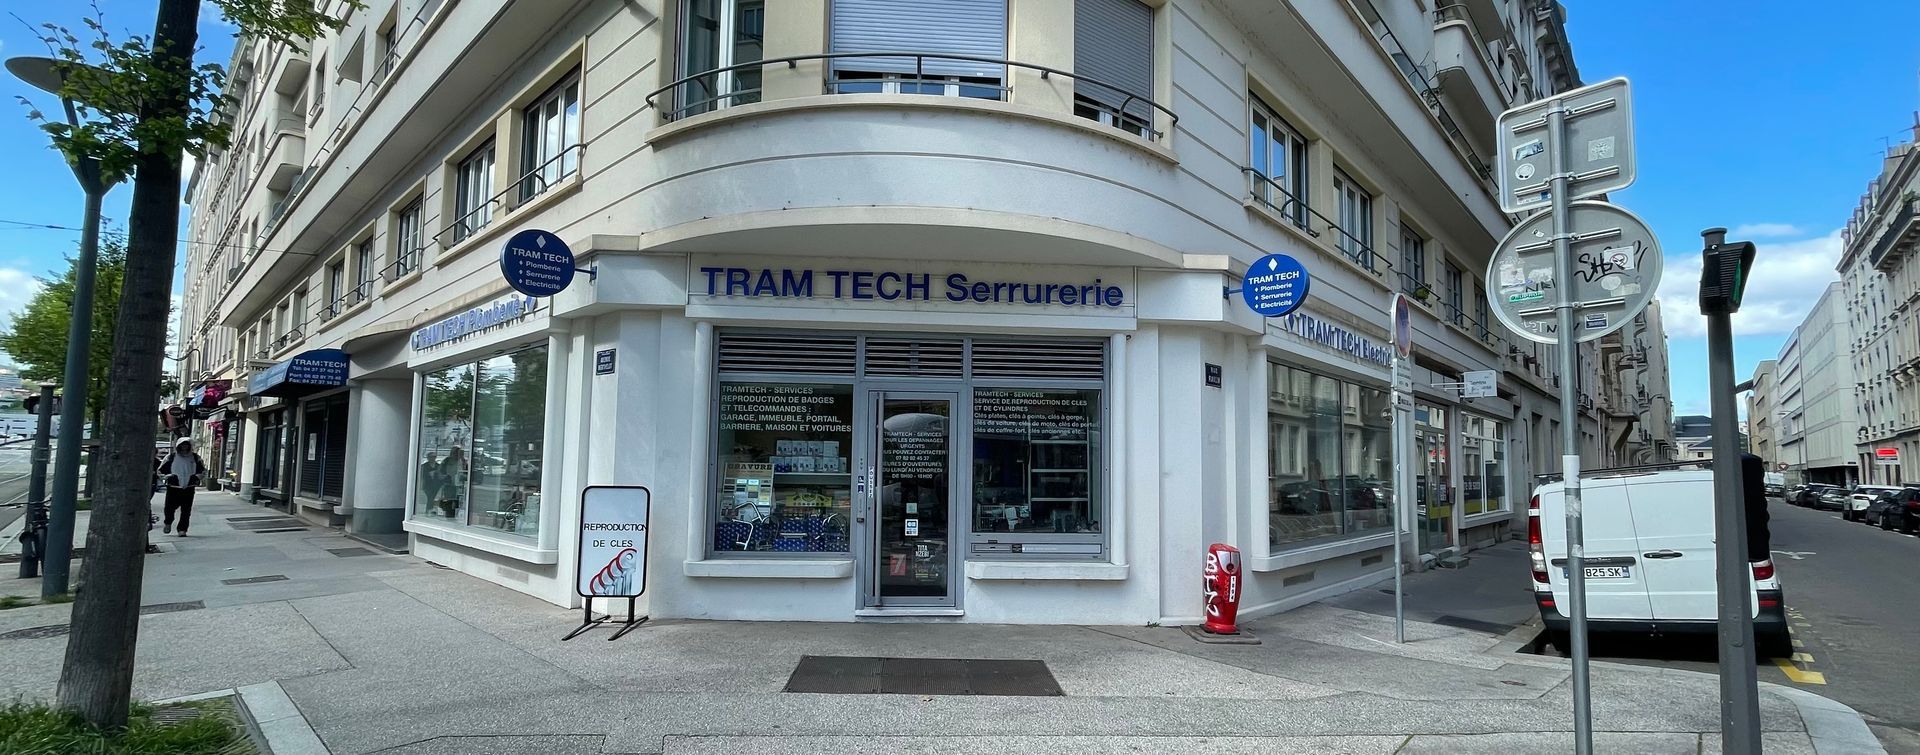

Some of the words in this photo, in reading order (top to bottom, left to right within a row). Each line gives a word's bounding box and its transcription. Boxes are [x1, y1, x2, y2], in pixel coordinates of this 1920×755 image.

[512, 247, 541, 259] TRAM
[543, 253, 569, 264] TECH
[526, 261, 561, 272] Plomberie
[526, 270, 561, 280] Serrurerie
[1248, 275, 1273, 285] TRAM
[1275, 271, 1299, 281] TECH
[525, 279, 561, 290] Electricité
[701, 267, 812, 298] TRAM
[827, 271, 930, 300] TECH
[945, 273, 1124, 307] Serrurerie
[1261, 283, 1293, 292] Plomberie
[1261, 291, 1293, 301] Serrurerie
[1260, 300, 1293, 309] Electricité
[468, 299, 521, 328] Plomberie
[722, 385, 767, 393] TRAMTECH
[721, 395, 786, 403] REPRODUCTION
[720, 414, 757, 422] GARAGE,
[758, 414, 804, 422] IMMEUBLE,
[807, 415, 842, 423] PORTAIL,
[720, 423, 763, 431] BARRIERE,
[728, 463, 773, 471] GRAVURE
[584, 523, 647, 531] REPRODUCTION
[1609, 568, 1622, 577] SK
